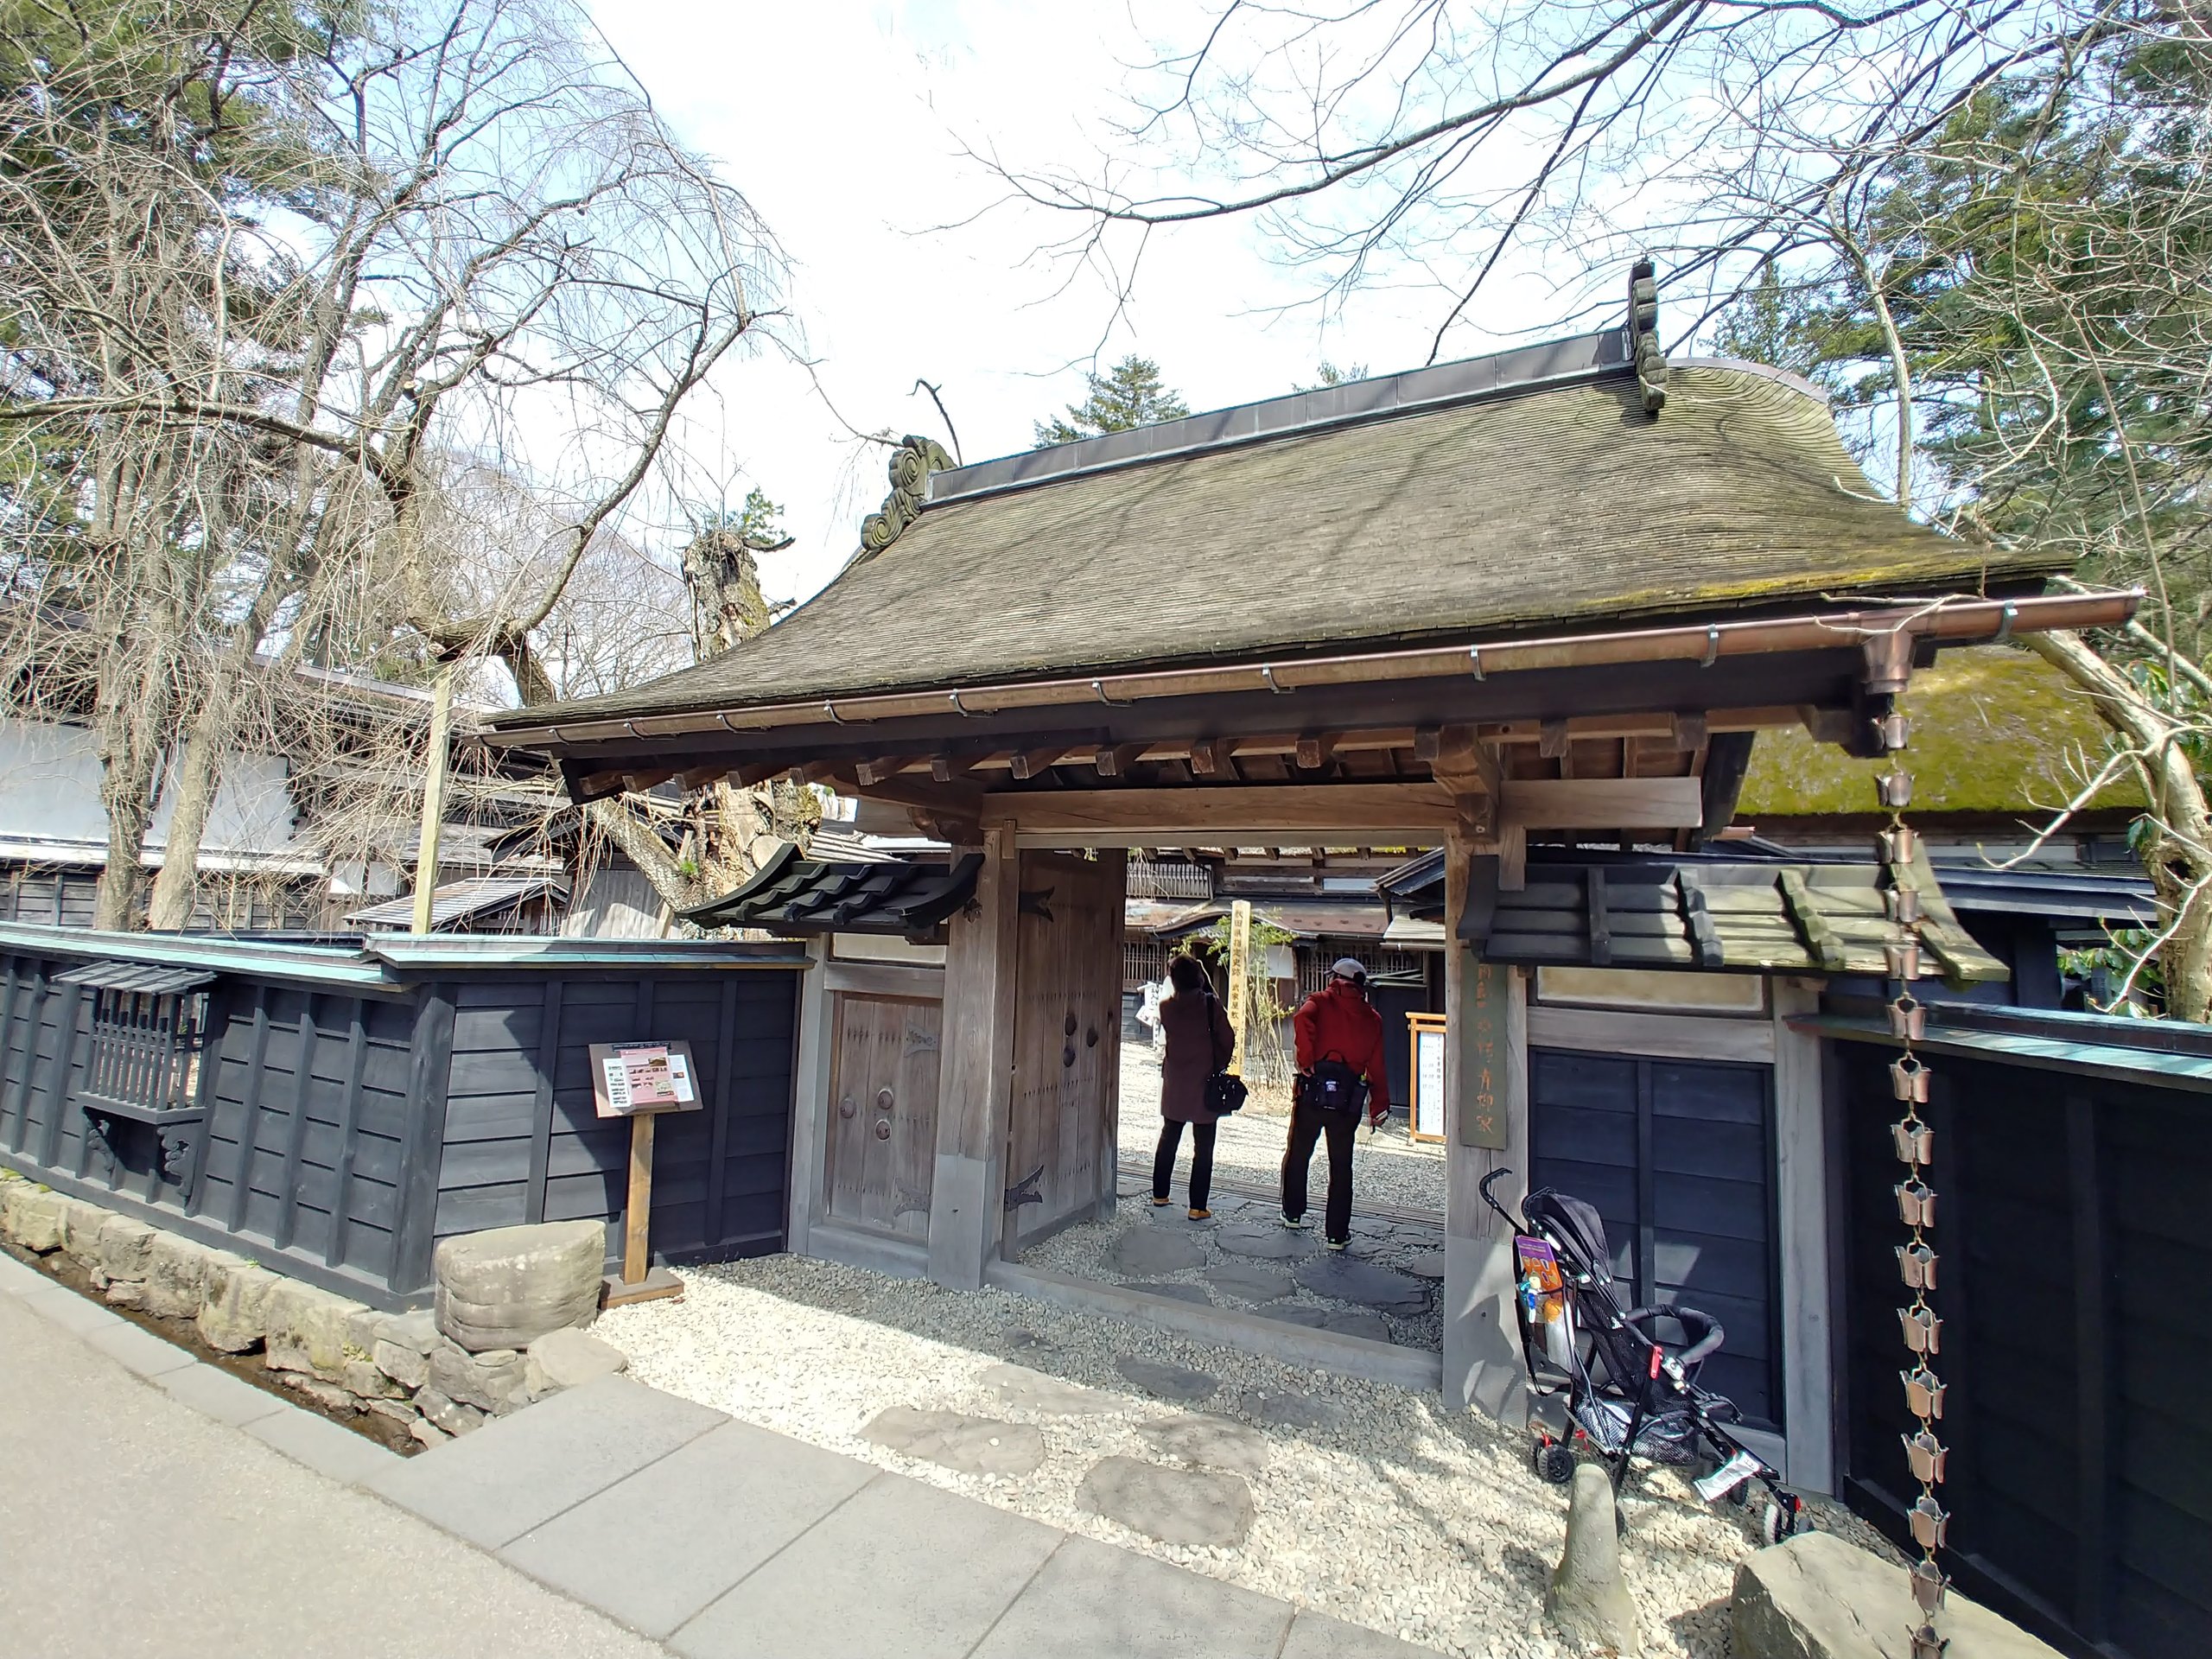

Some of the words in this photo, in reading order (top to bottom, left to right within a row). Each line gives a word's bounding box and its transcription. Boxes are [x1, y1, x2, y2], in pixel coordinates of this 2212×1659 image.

[1231, 910, 1244, 976] 秋田県指定史跡
